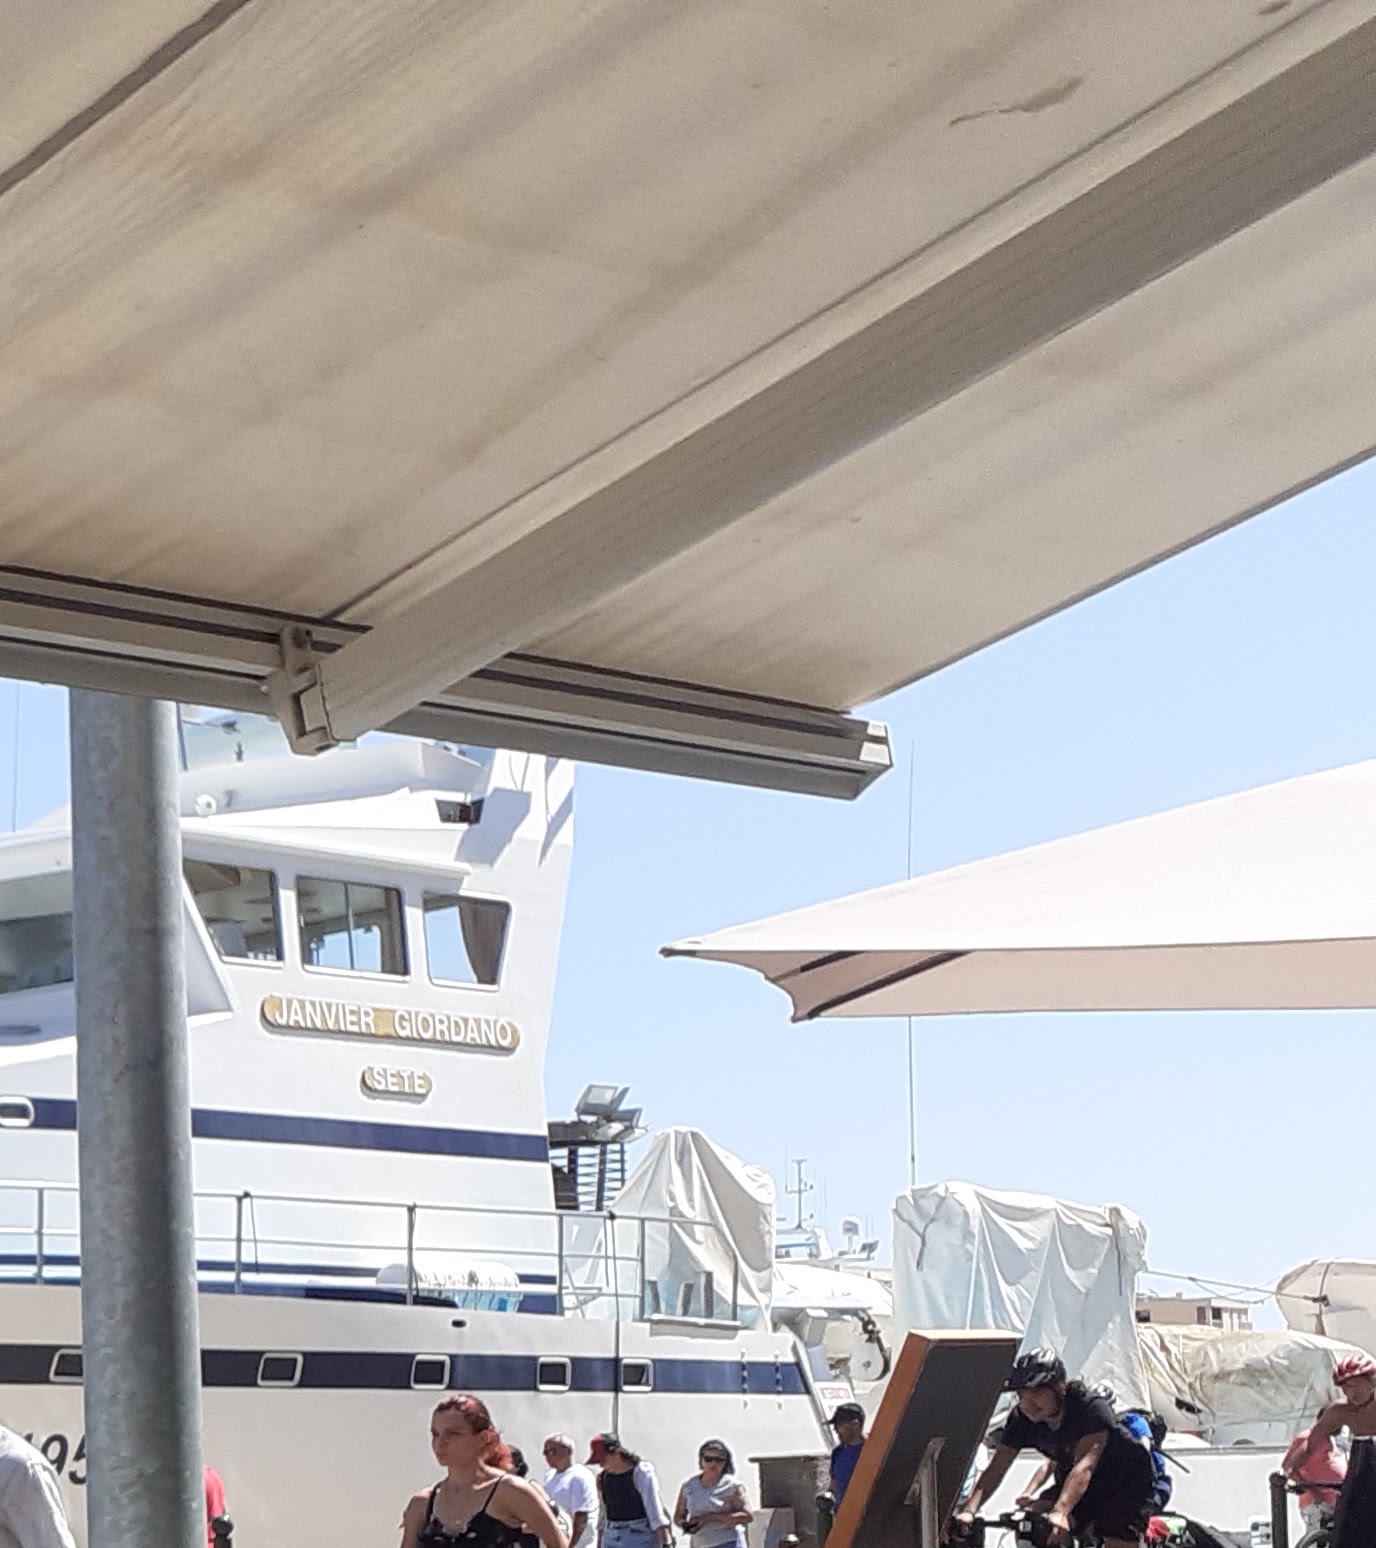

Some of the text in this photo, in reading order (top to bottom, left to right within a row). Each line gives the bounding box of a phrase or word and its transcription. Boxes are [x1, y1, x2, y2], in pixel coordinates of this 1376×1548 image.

[275, 1000, 513, 1047] JANVIER GIORDANO
[371, 1067, 428, 1094] SETE
